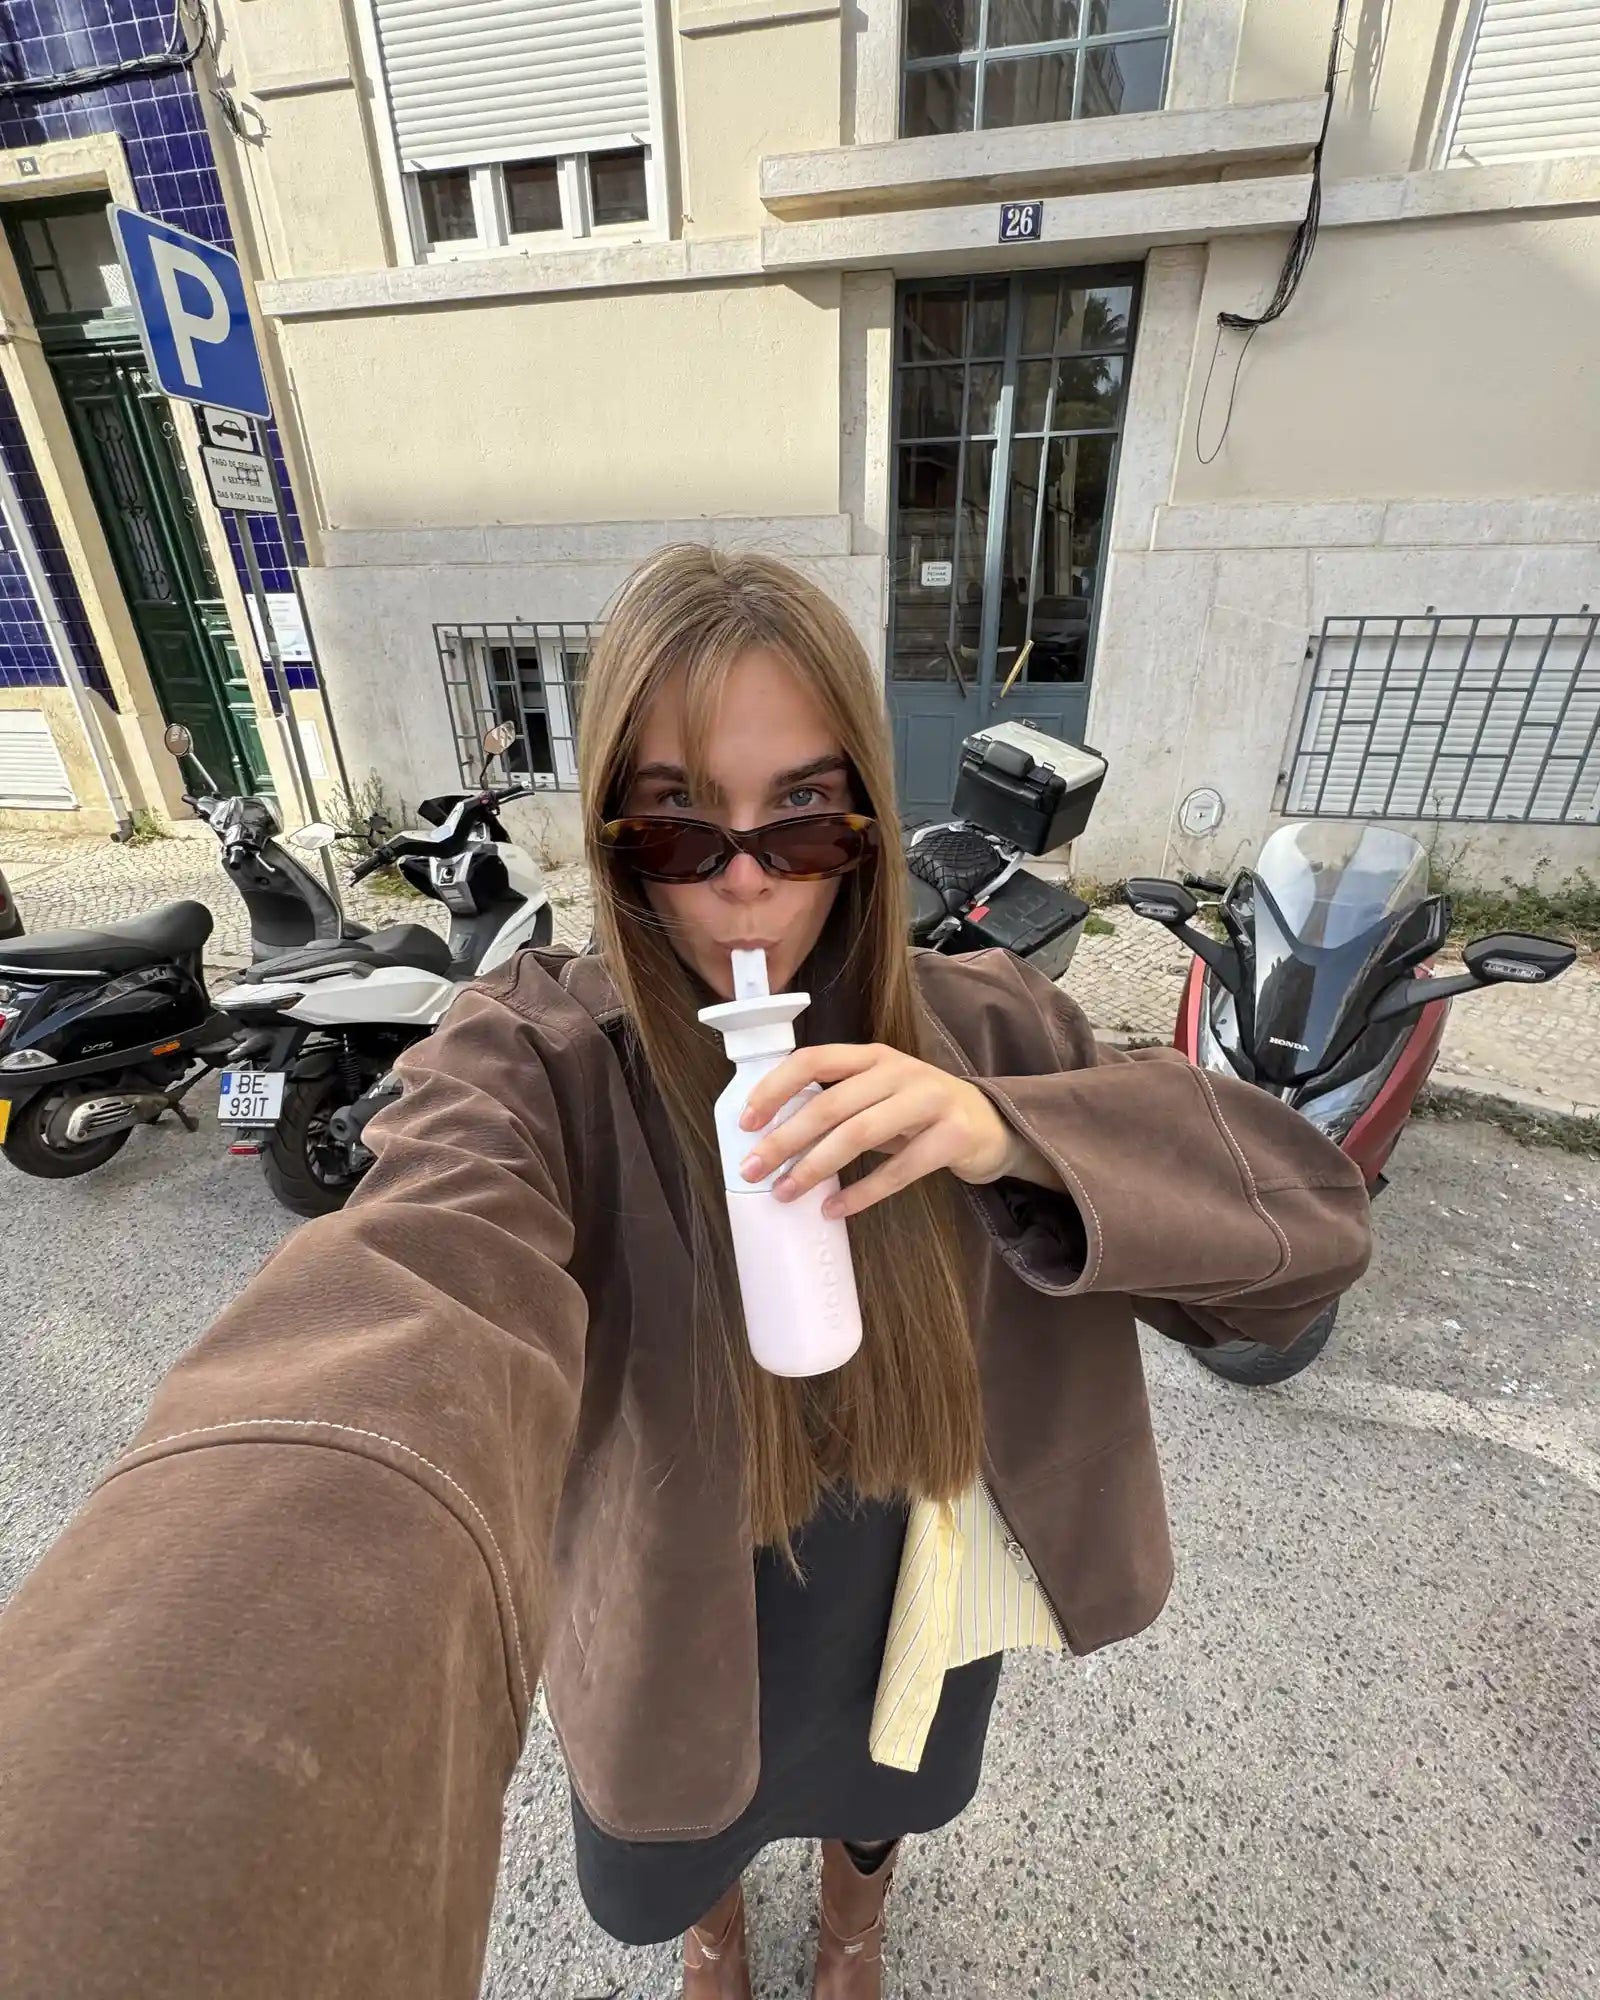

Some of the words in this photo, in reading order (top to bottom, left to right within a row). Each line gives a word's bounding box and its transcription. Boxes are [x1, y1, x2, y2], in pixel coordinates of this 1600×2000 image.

[1006, 206, 1033, 236] 26
[148, 234, 230, 388] P
[1269, 1036, 1310, 1052] HONDA
[238, 1075, 265, 1094] BE
